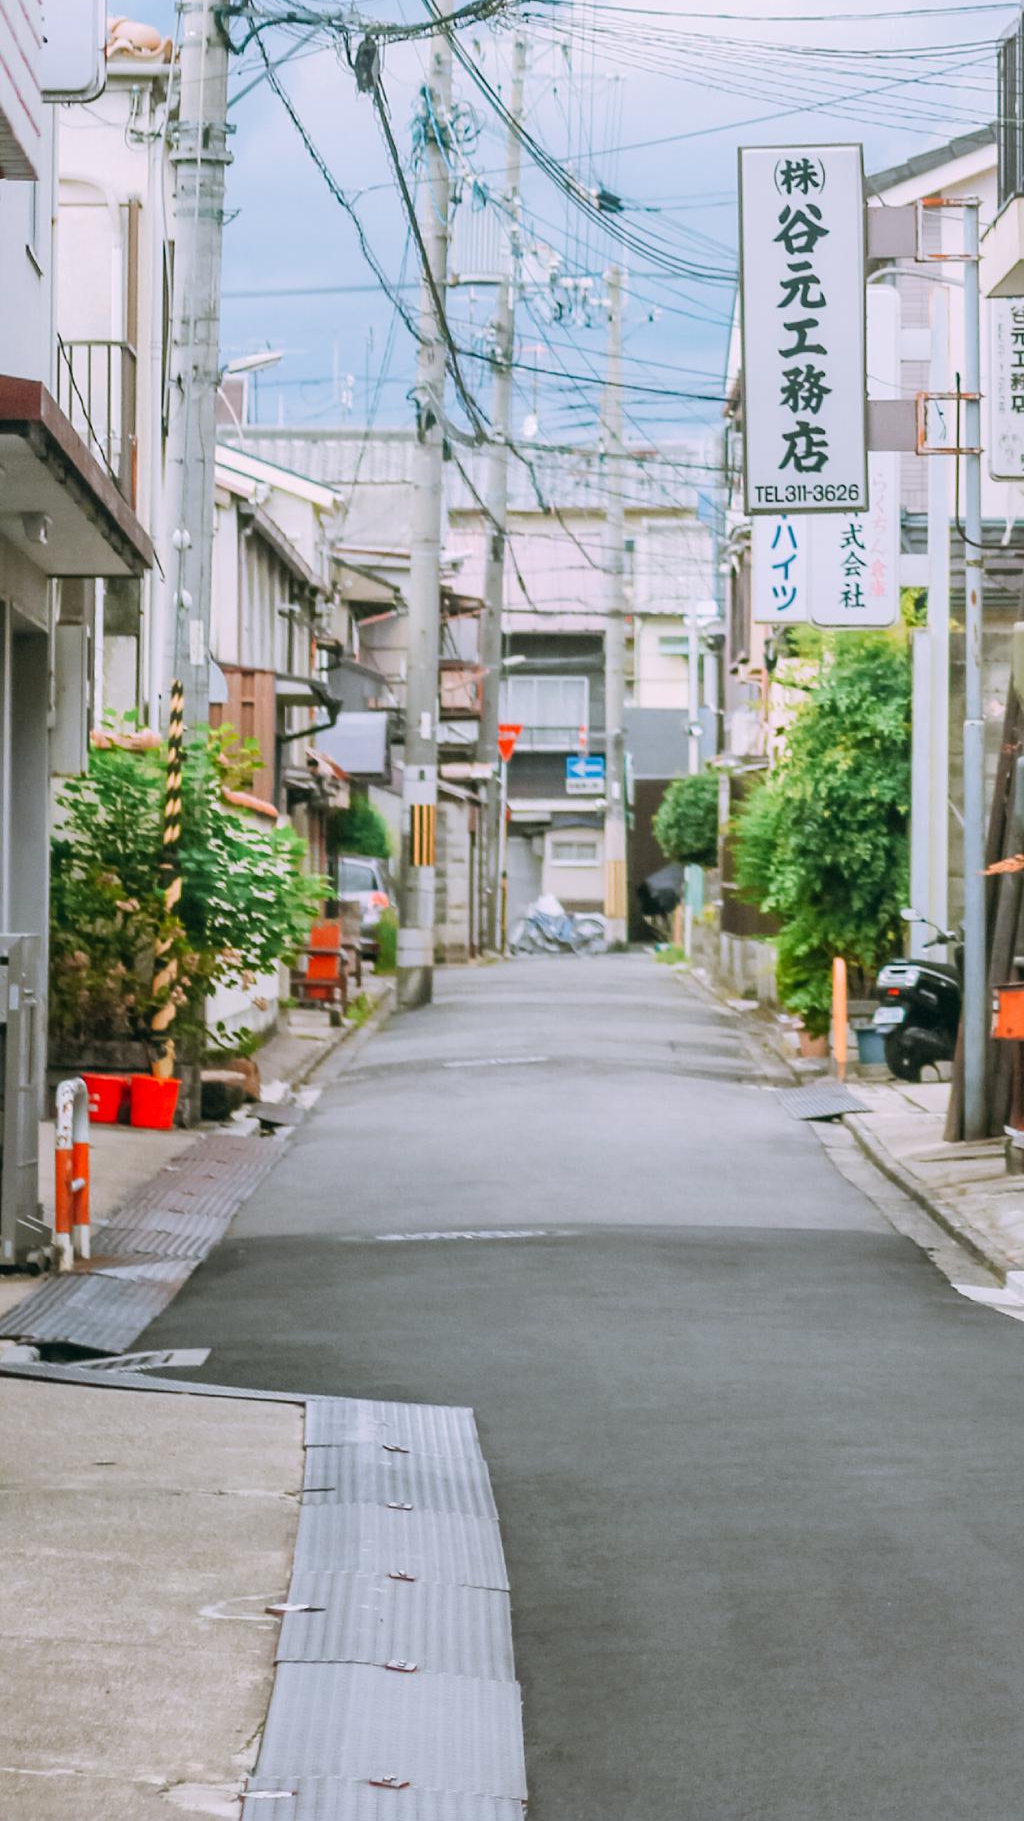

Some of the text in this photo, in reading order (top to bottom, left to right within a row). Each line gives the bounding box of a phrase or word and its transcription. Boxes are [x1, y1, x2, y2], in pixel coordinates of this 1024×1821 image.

[770, 514, 798, 612] ハイツ
[839, 512, 868, 609] 式会社
